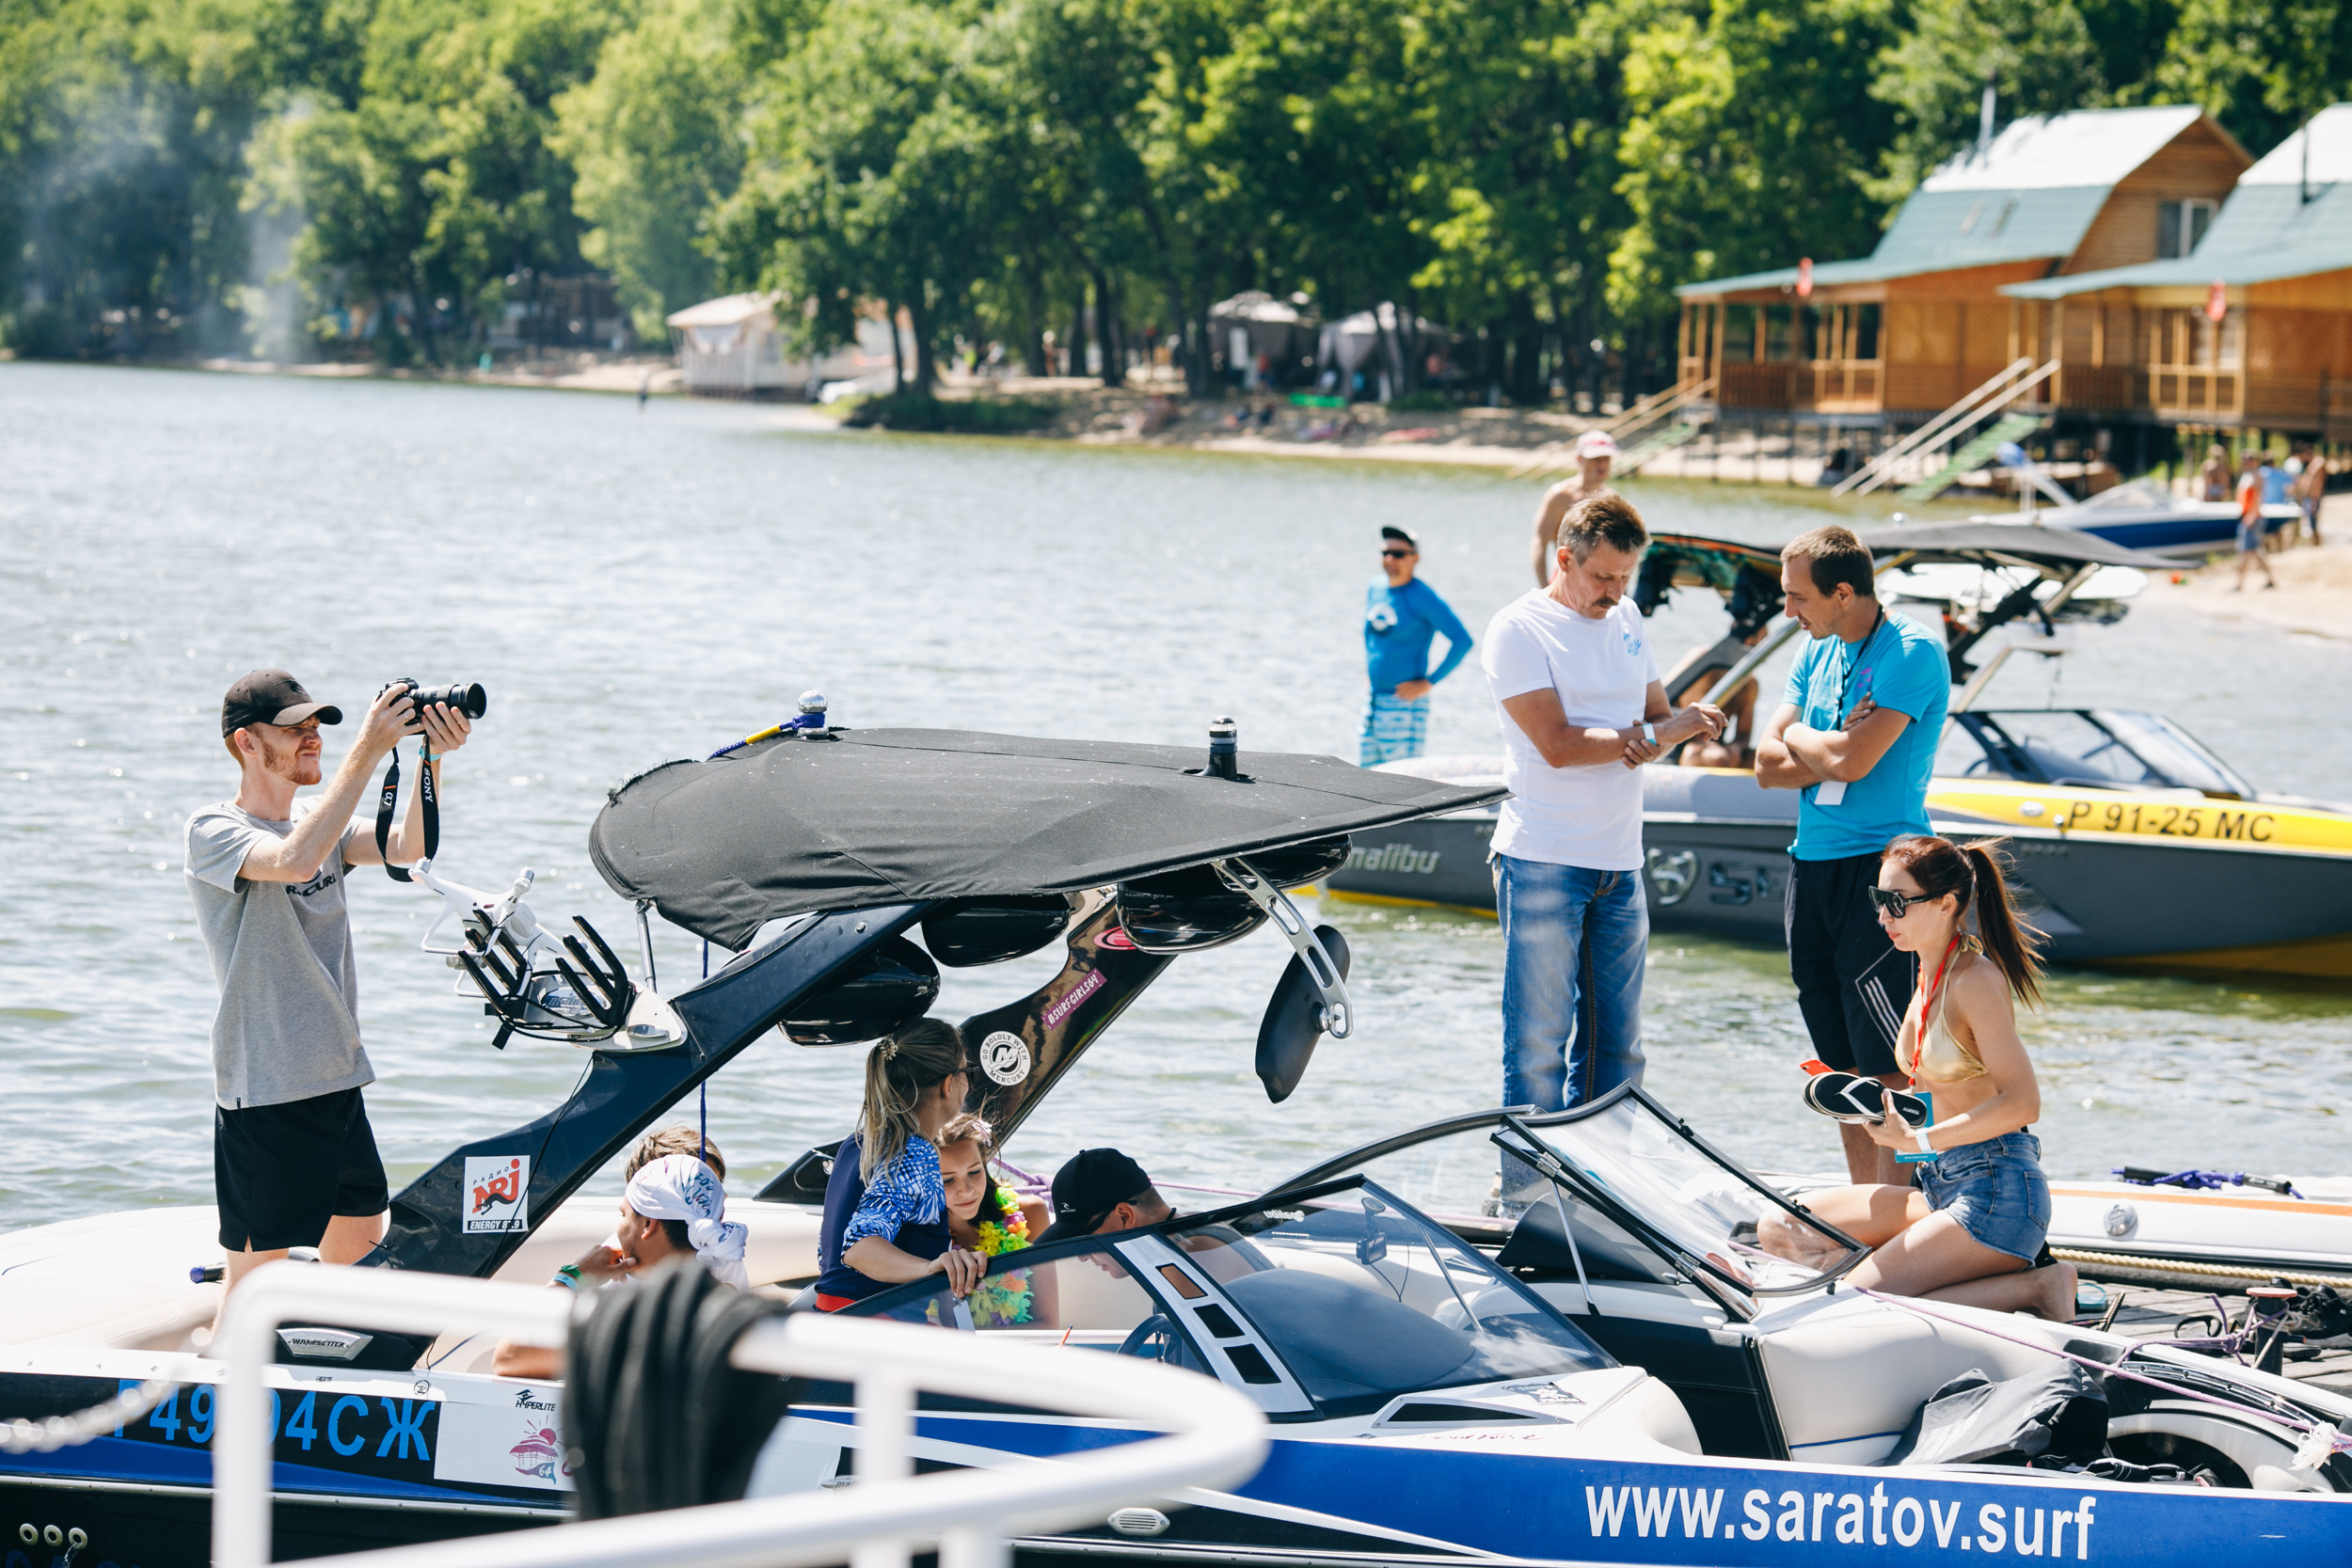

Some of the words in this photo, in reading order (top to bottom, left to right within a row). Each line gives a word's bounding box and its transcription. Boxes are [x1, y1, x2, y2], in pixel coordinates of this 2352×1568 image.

[423, 768, 433, 802] SONY
[2104, 806, 2201, 837] 91-25
[1047, 974, 1099, 1024] #SURFGIRLS64
[985, 1034, 1012, 1048] BOLDLY
[982, 1049, 989, 1060] GO
[1013, 1038, 1028, 1060] WITH
[989, 1069, 1025, 1084] MERCURY
[470, 1220, 500, 1230] ENERGY
[292, 1338, 345, 1349] WAKESETTER
[516, 1400, 557, 1412] HYPERLITE
[538, 1465, 552, 1477] 64
[1585, 1481, 2096, 1560] www.saratov.surf
